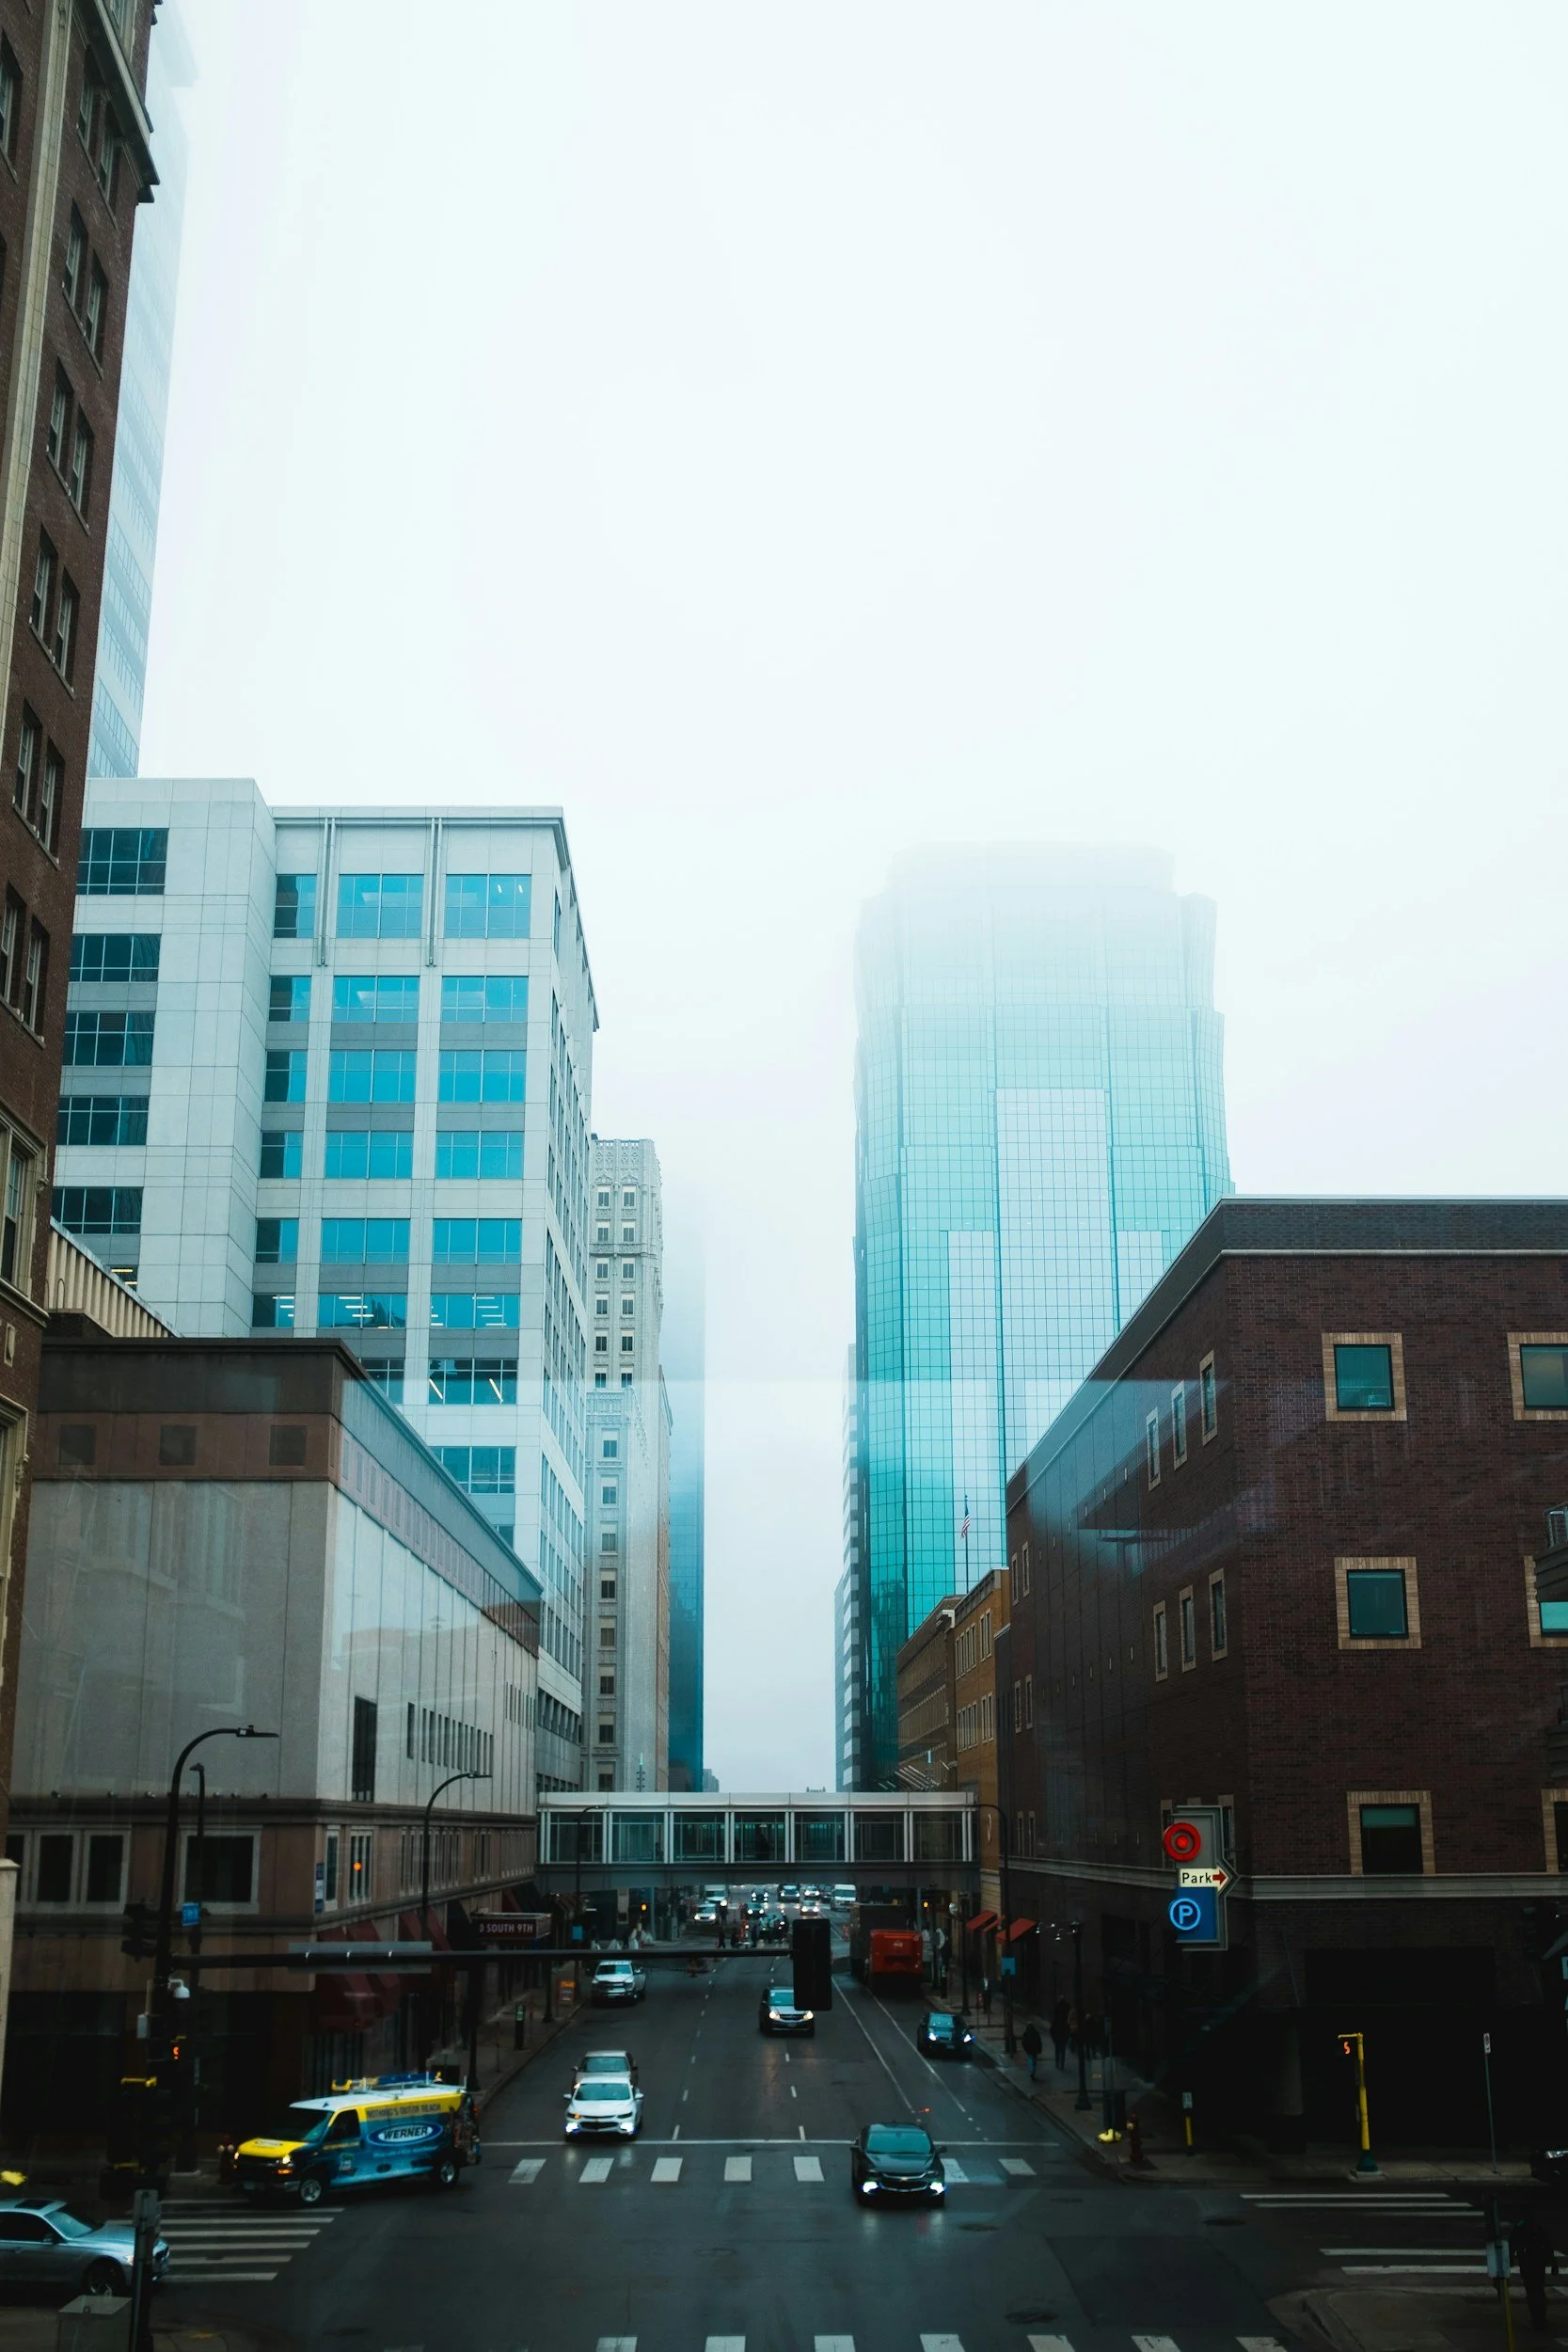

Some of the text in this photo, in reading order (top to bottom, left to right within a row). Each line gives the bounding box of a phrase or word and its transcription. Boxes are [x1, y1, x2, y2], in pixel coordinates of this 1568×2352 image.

[1182, 1872, 1212, 1883] Park
[1179, 1904, 1194, 1925] P
[487, 1924, 515, 1932] SOUTH
[516, 1924, 533, 1932] 9TH
[384, 2126, 428, 2140] WERNER
